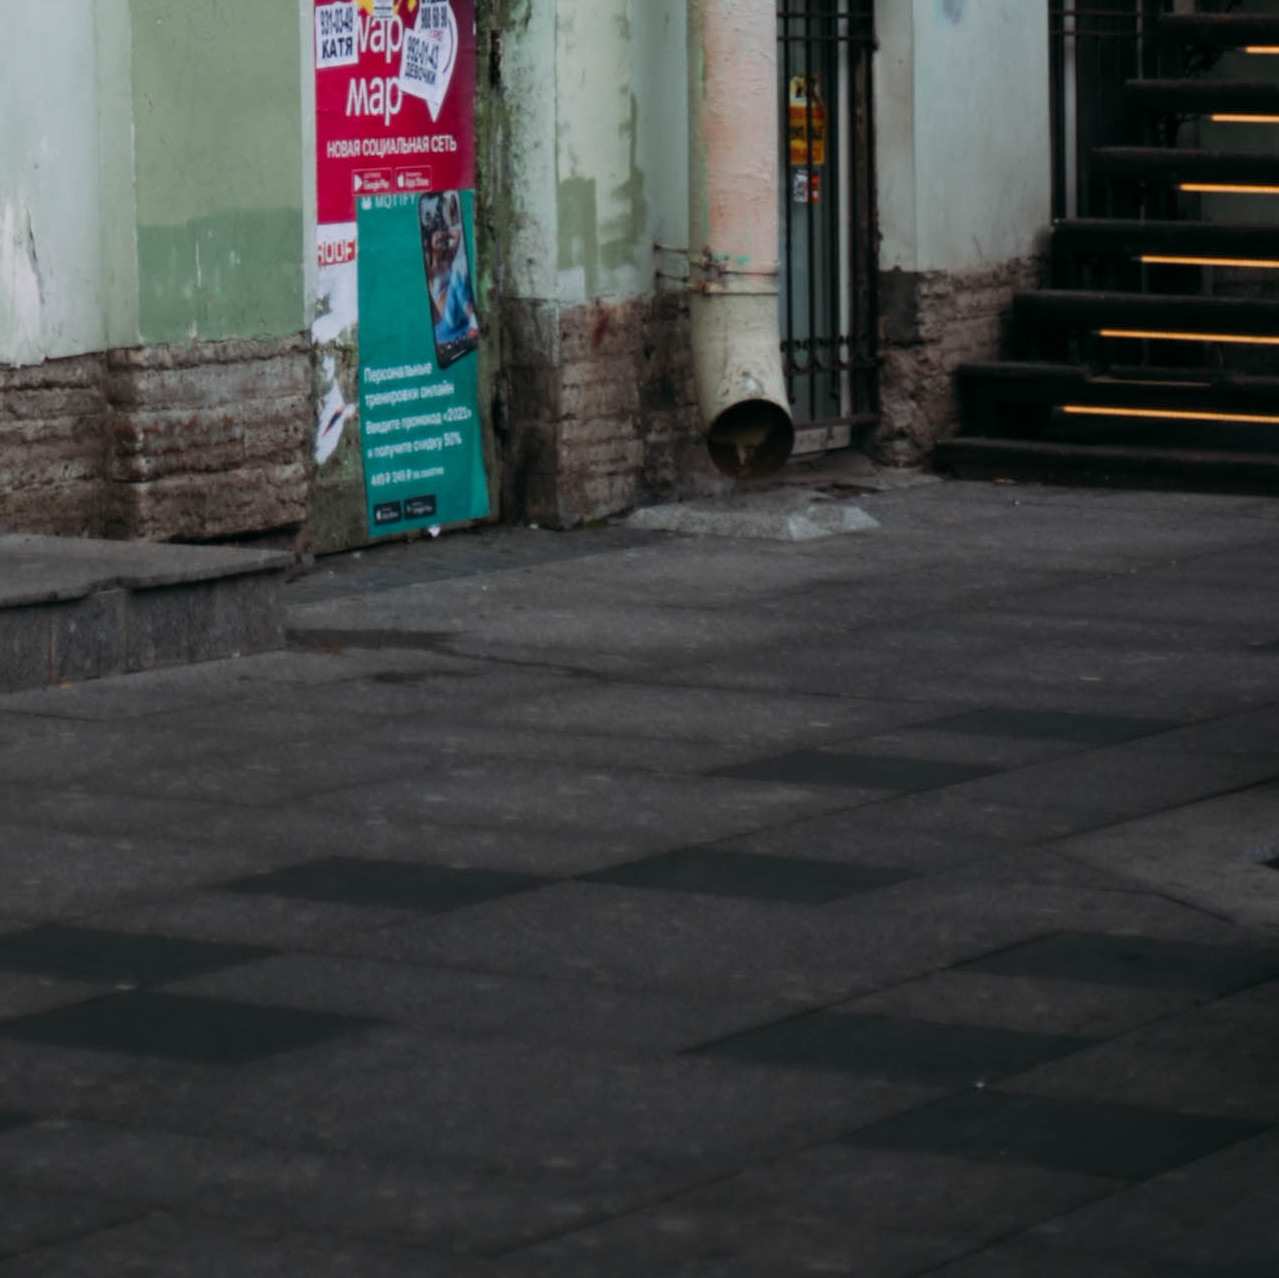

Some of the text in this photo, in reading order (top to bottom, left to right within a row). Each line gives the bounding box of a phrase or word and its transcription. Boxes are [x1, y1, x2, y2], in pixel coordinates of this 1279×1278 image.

[322, 37, 353, 59] КАТЯ
[326, 135, 457, 158] НОВАЯ СОЦИАЛЬНАЯ СЕТЬ
[421, 379, 455, 399] онлайн
